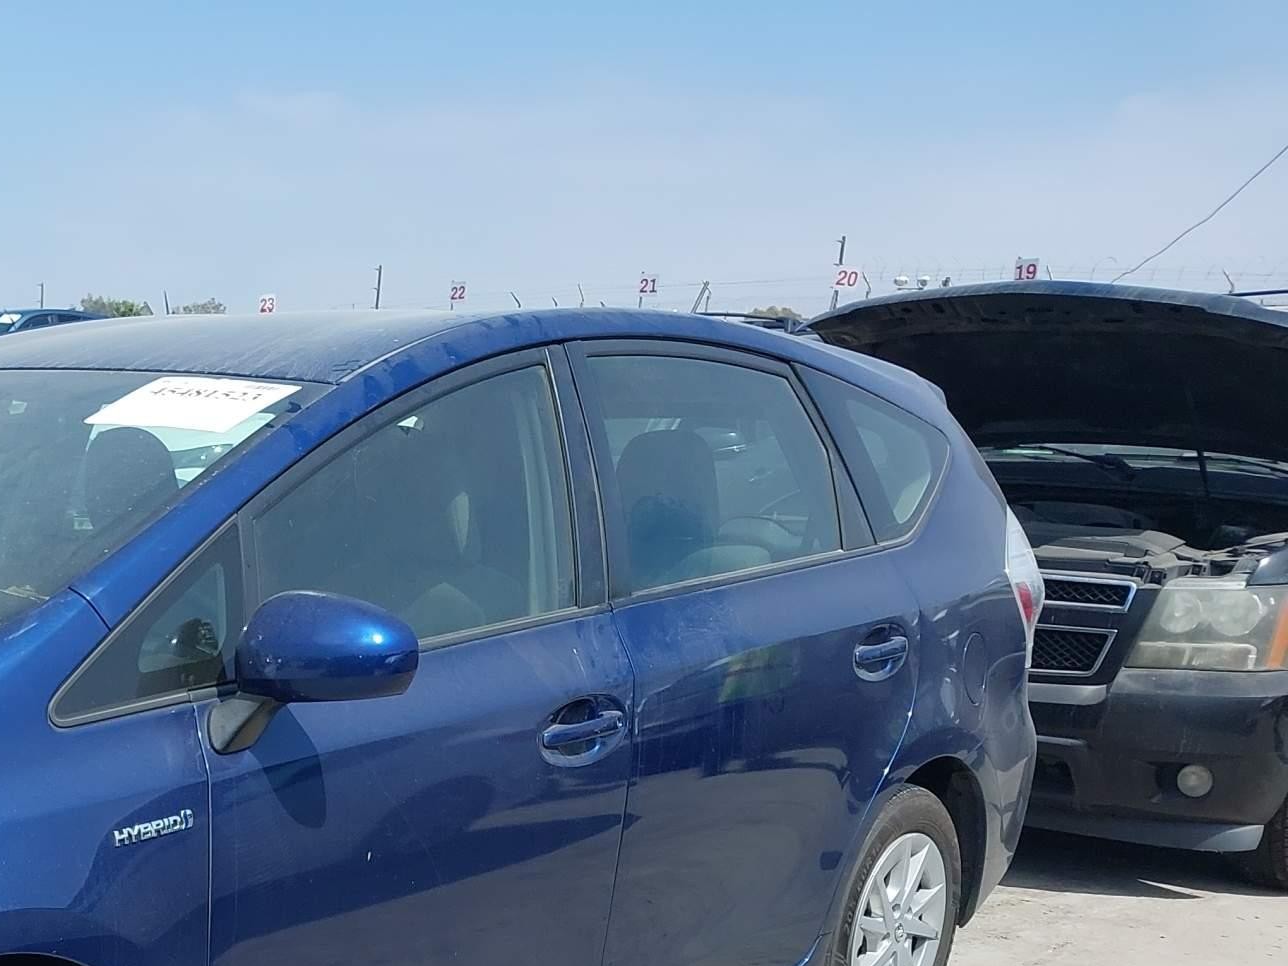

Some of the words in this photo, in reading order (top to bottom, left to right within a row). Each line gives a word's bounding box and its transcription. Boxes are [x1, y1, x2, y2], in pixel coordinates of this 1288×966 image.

[835, 270, 858, 287] 20
[1014, 263, 1037, 281] 19
[450, 285, 465, 300] 22
[639, 278, 657, 294] 21
[259, 297, 275, 313] 23
[113, 815, 181, 847] HYBRID
